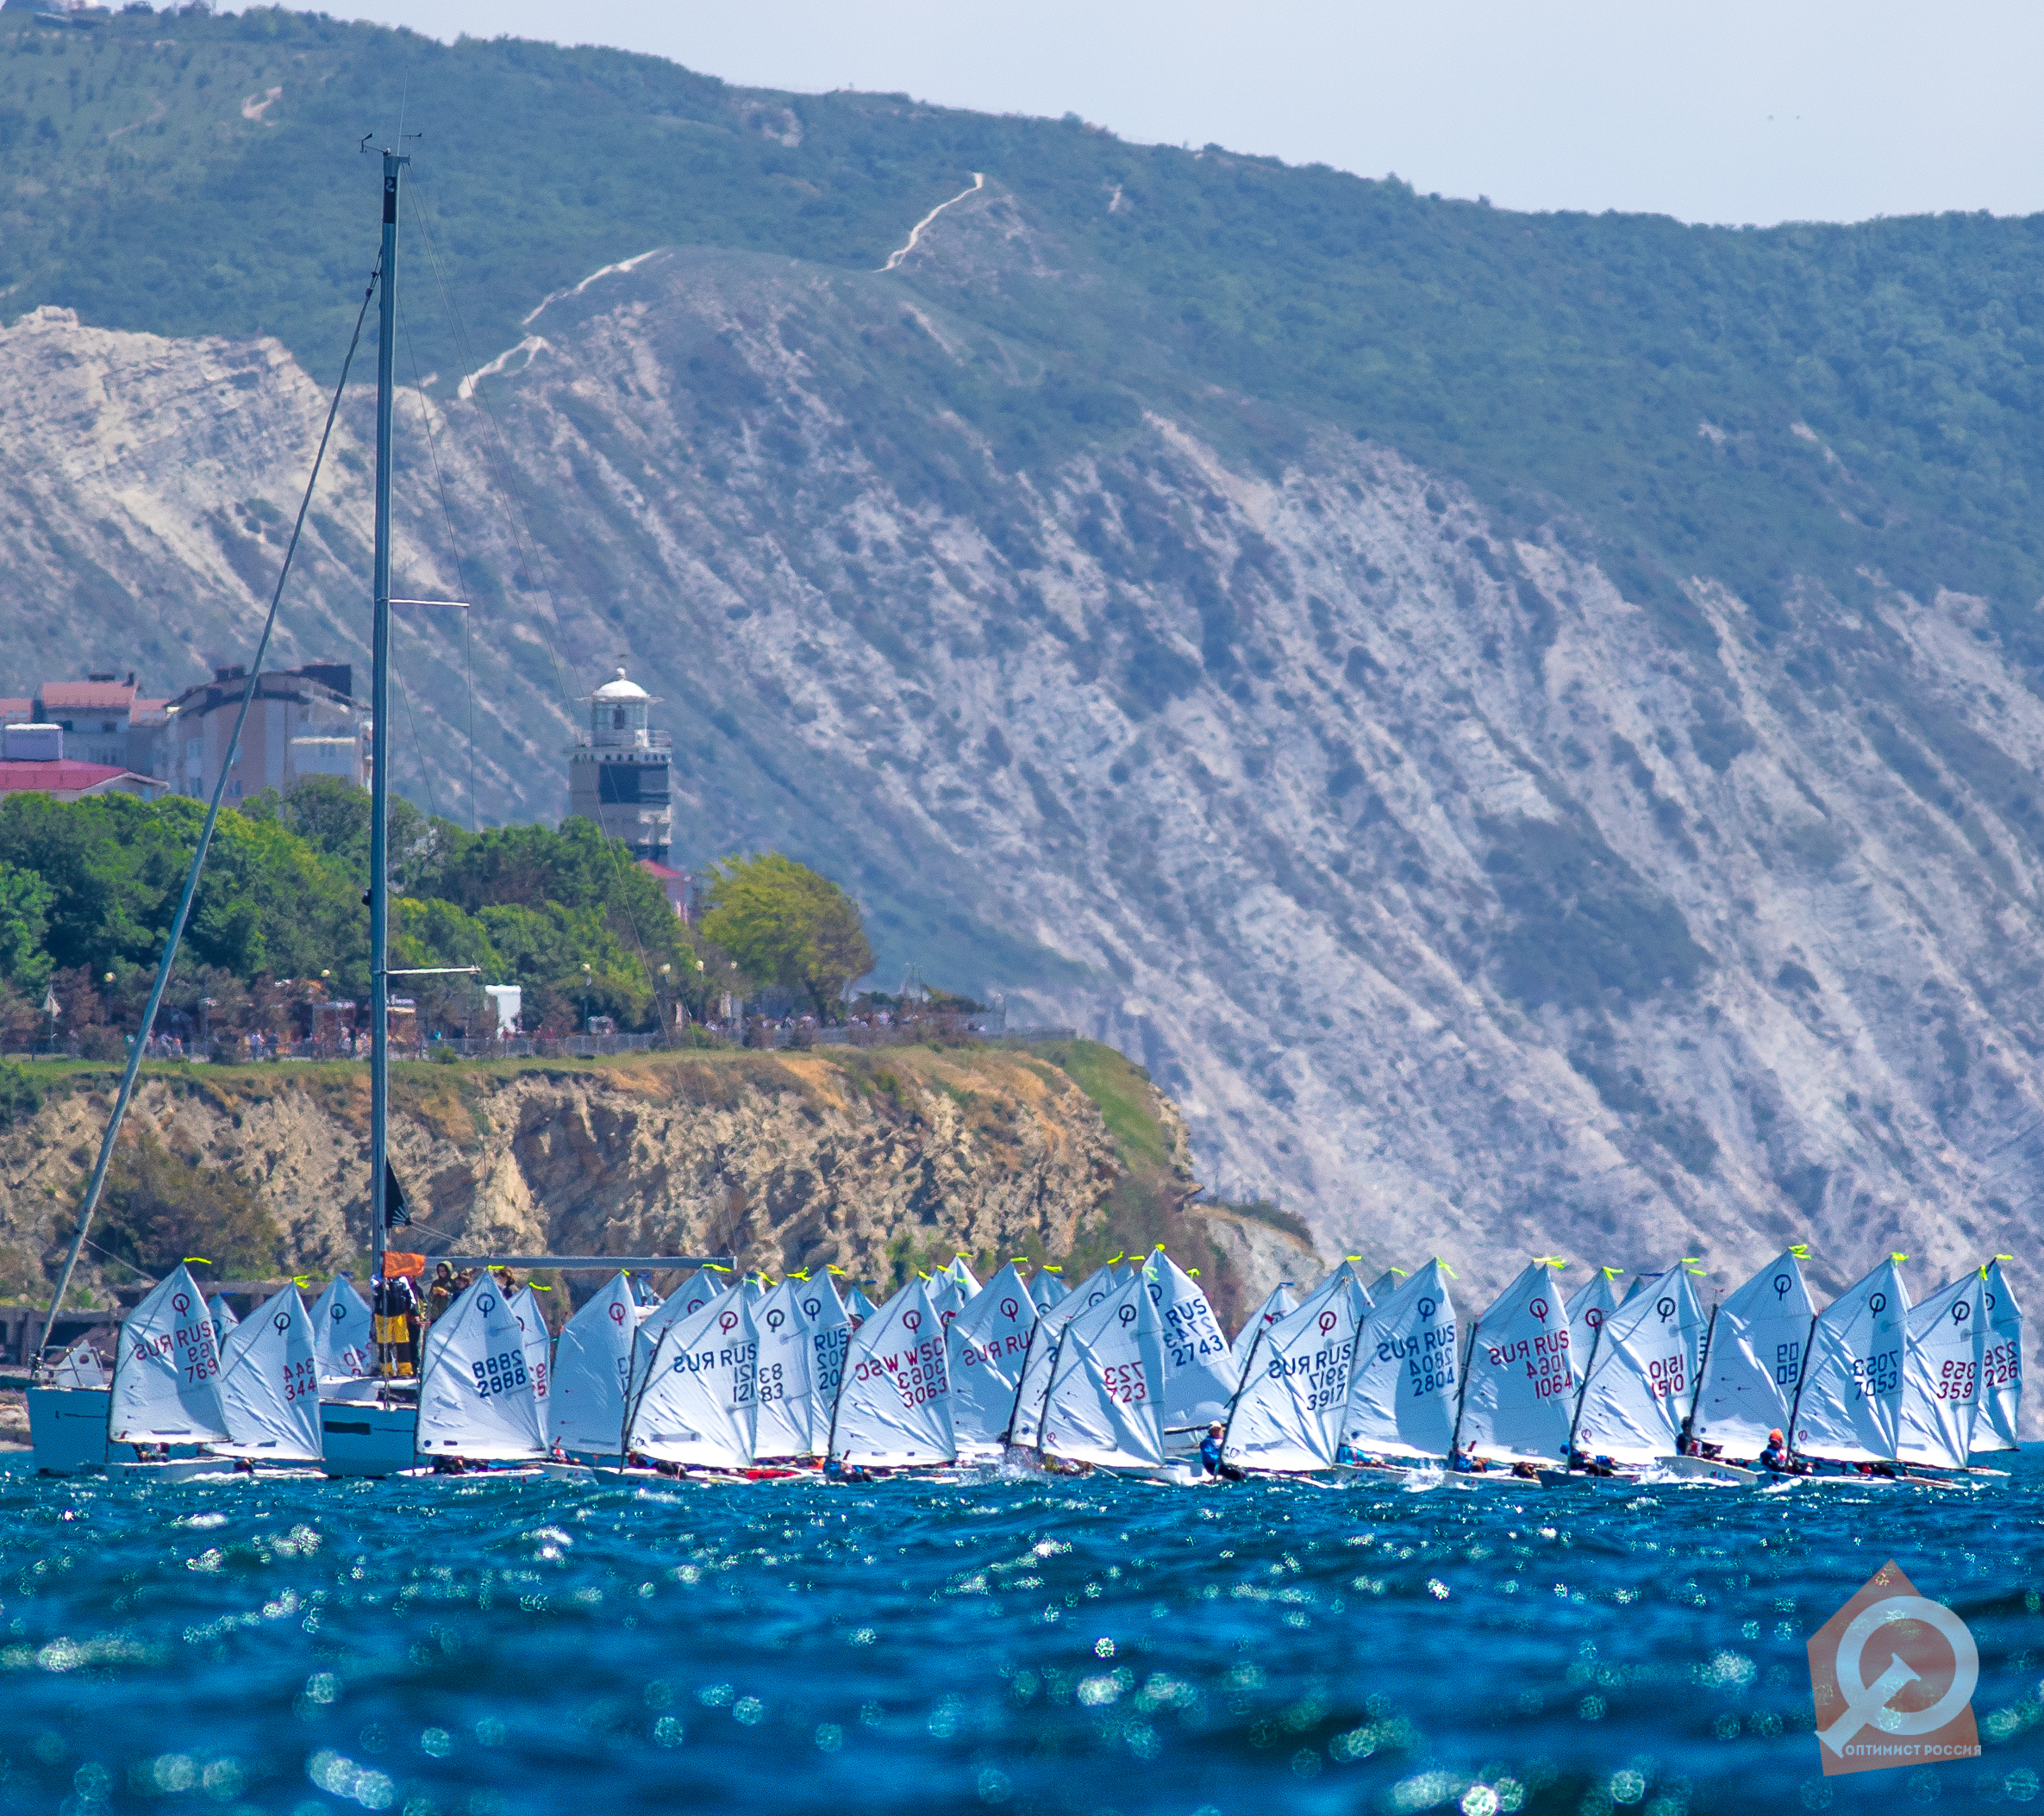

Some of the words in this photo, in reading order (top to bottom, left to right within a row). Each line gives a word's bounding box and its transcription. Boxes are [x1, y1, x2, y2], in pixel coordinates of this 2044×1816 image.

[1166, 1299, 1207, 1327] RUS
[176, 1320, 211, 1348] RUS
[815, 1328, 847, 1351] RUS
[1005, 1330, 1034, 1356] RU
[1424, 1325, 1455, 1351] RUS
[1534, 1330, 1569, 1356] RUS
[721, 1343, 757, 1367] RUS
[903, 1336, 944, 1366] WSC
[1172, 1334, 1223, 1367] 2743
[1316, 1344, 1351, 1370] RUS
[184, 1357, 218, 1383] 769
[477, 1367, 527, 1398] 2888
[1411, 1366, 1455, 1397] 2804
[1985, 1360, 2018, 1388] 226
[285, 1376, 316, 1401] 344
[733, 1382, 754, 1403] 121
[760, 1382, 783, 1402] 83
[901, 1376, 947, 1408] 3063
[1106, 1382, 1147, 1405] 723
[1306, 1382, 1346, 1411] 3917
[1535, 1371, 1572, 1400] 1064
[1651, 1373, 1685, 1401] 1510
[1854, 1370, 1897, 1401] 7053
[1936, 1381, 1973, 1400] 359
